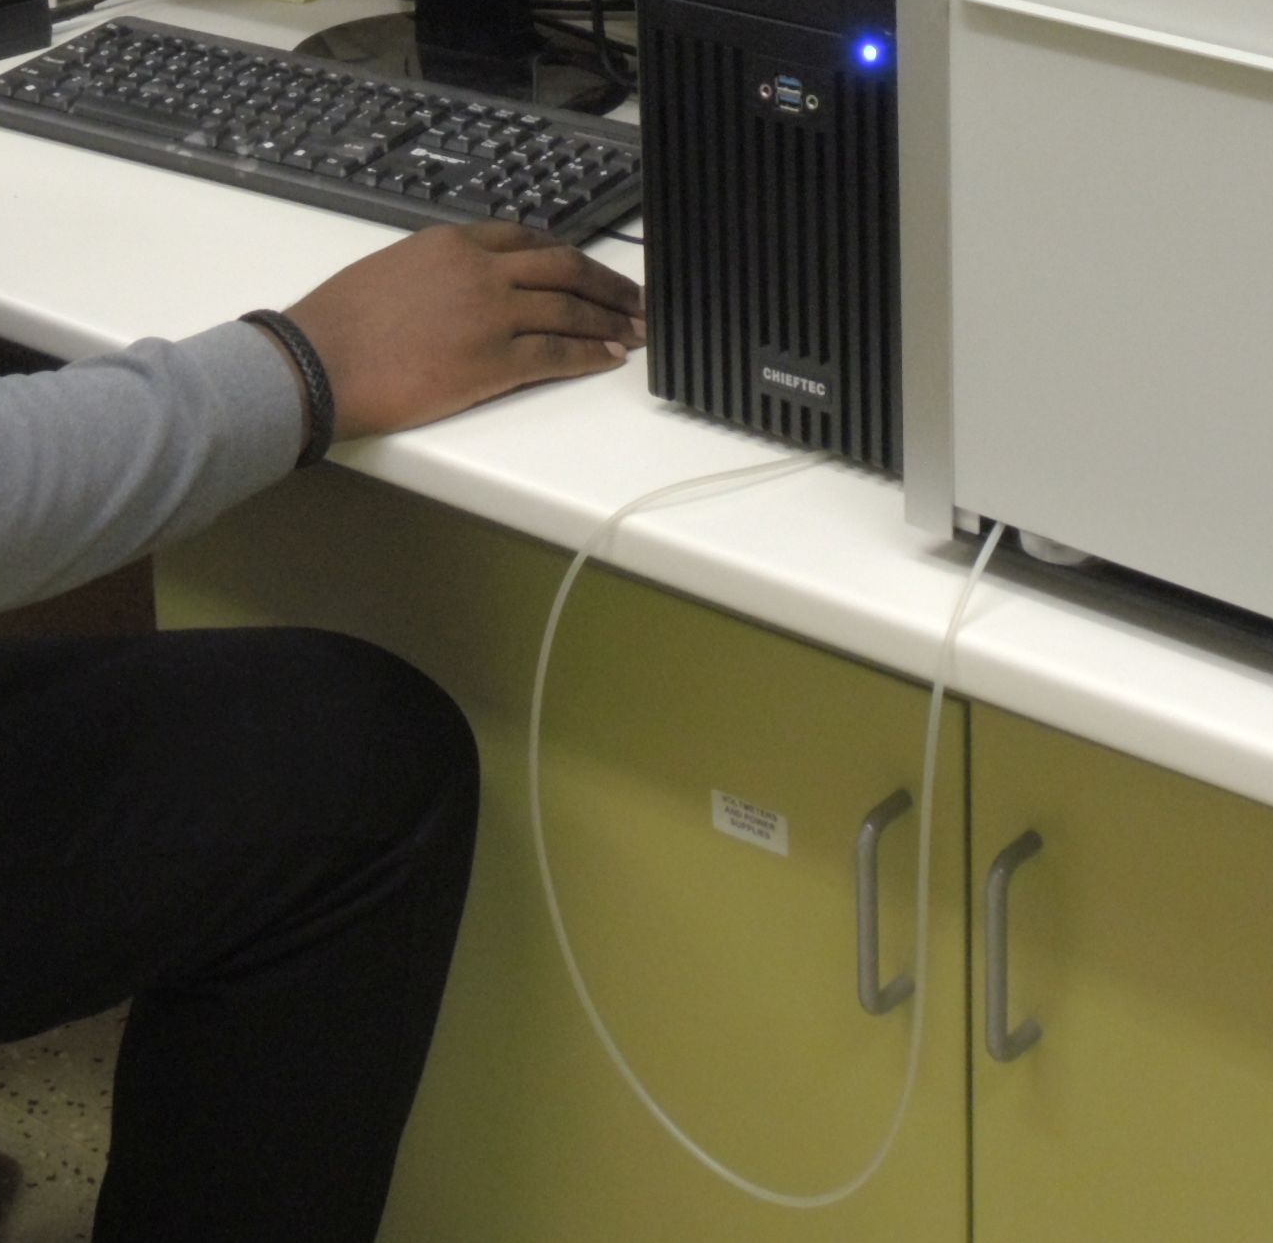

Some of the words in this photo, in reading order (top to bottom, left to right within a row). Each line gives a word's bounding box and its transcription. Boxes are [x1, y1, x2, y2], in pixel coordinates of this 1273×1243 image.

[762, 366, 826, 397] CHIEFTEC
[725, 805, 743, 819] AND
[744, 813, 775, 831] POWER
[730, 817, 771, 840] SUPPLIES
